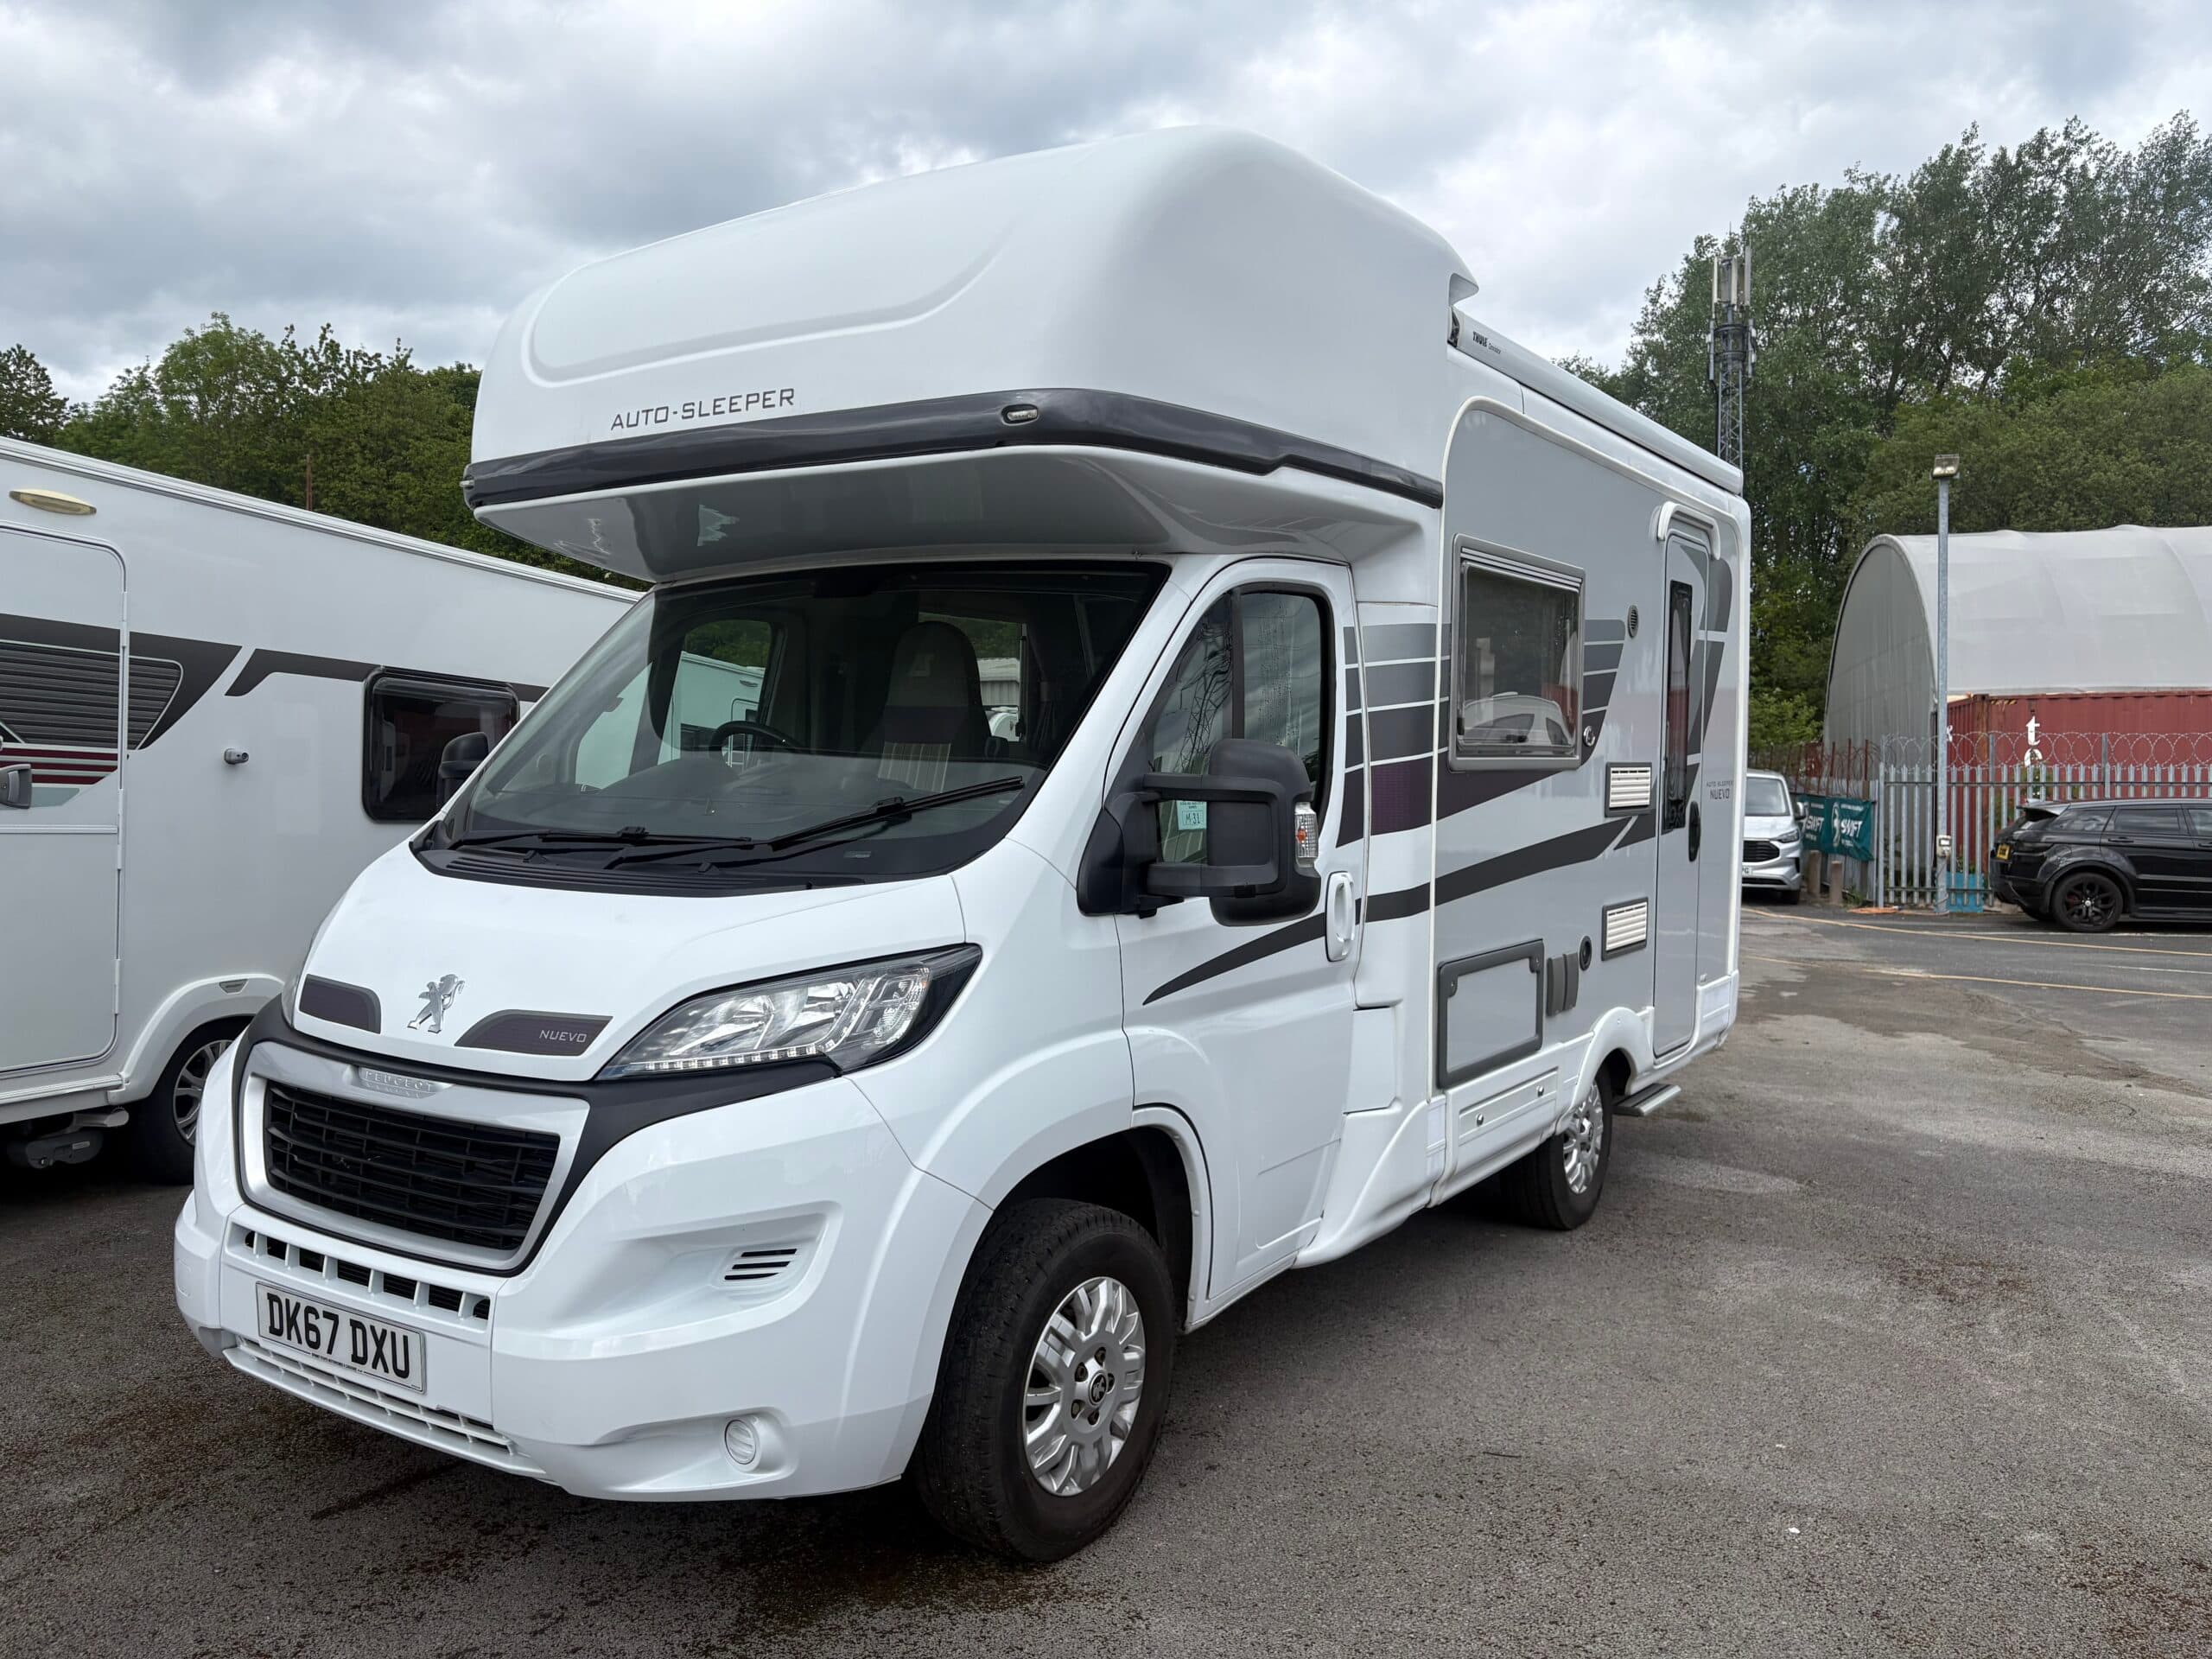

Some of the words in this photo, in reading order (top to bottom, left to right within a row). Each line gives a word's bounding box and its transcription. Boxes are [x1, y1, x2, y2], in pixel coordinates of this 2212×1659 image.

[611, 388, 795, 430] AUTO-SLEEPER
[1710, 788, 1730, 799] NUEVO
[1840, 817, 1863, 838] SWIFT
[539, 1029, 587, 1043] NUEVO
[365, 1071, 433, 1092] PEUGEOT
[267, 1293, 340, 1355] DK67
[350, 1319, 410, 1379] DXU
